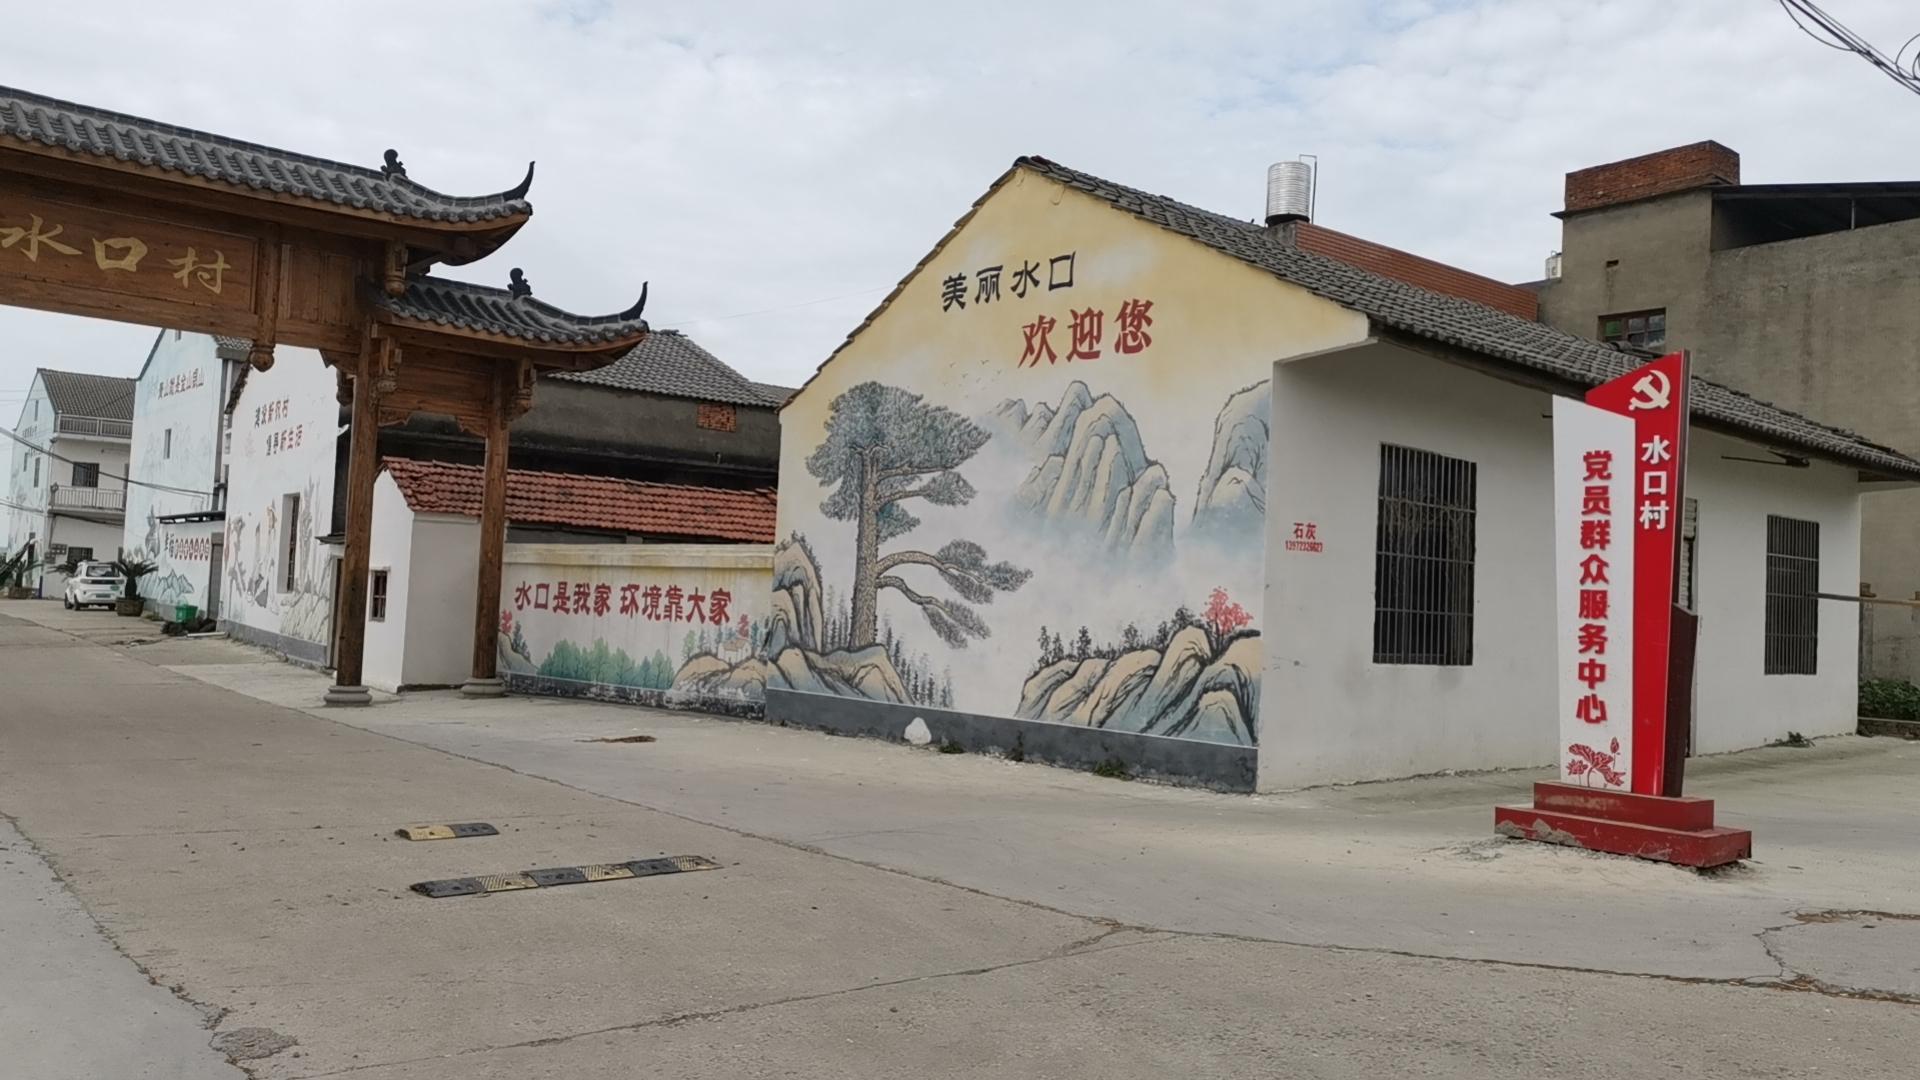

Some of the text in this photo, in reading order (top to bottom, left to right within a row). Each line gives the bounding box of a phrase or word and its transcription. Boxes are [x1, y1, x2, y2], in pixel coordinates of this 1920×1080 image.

[0, 212, 232, 295] 水口村
[941, 250, 1076, 313] 美丽水口
[1018, 298, 1155, 369] 欢迎您
[1639, 434, 1672, 530] 水口村
[1293, 522, 1317, 540] 石灰
[1576, 450, 1613, 725] 党员群众服务中心
